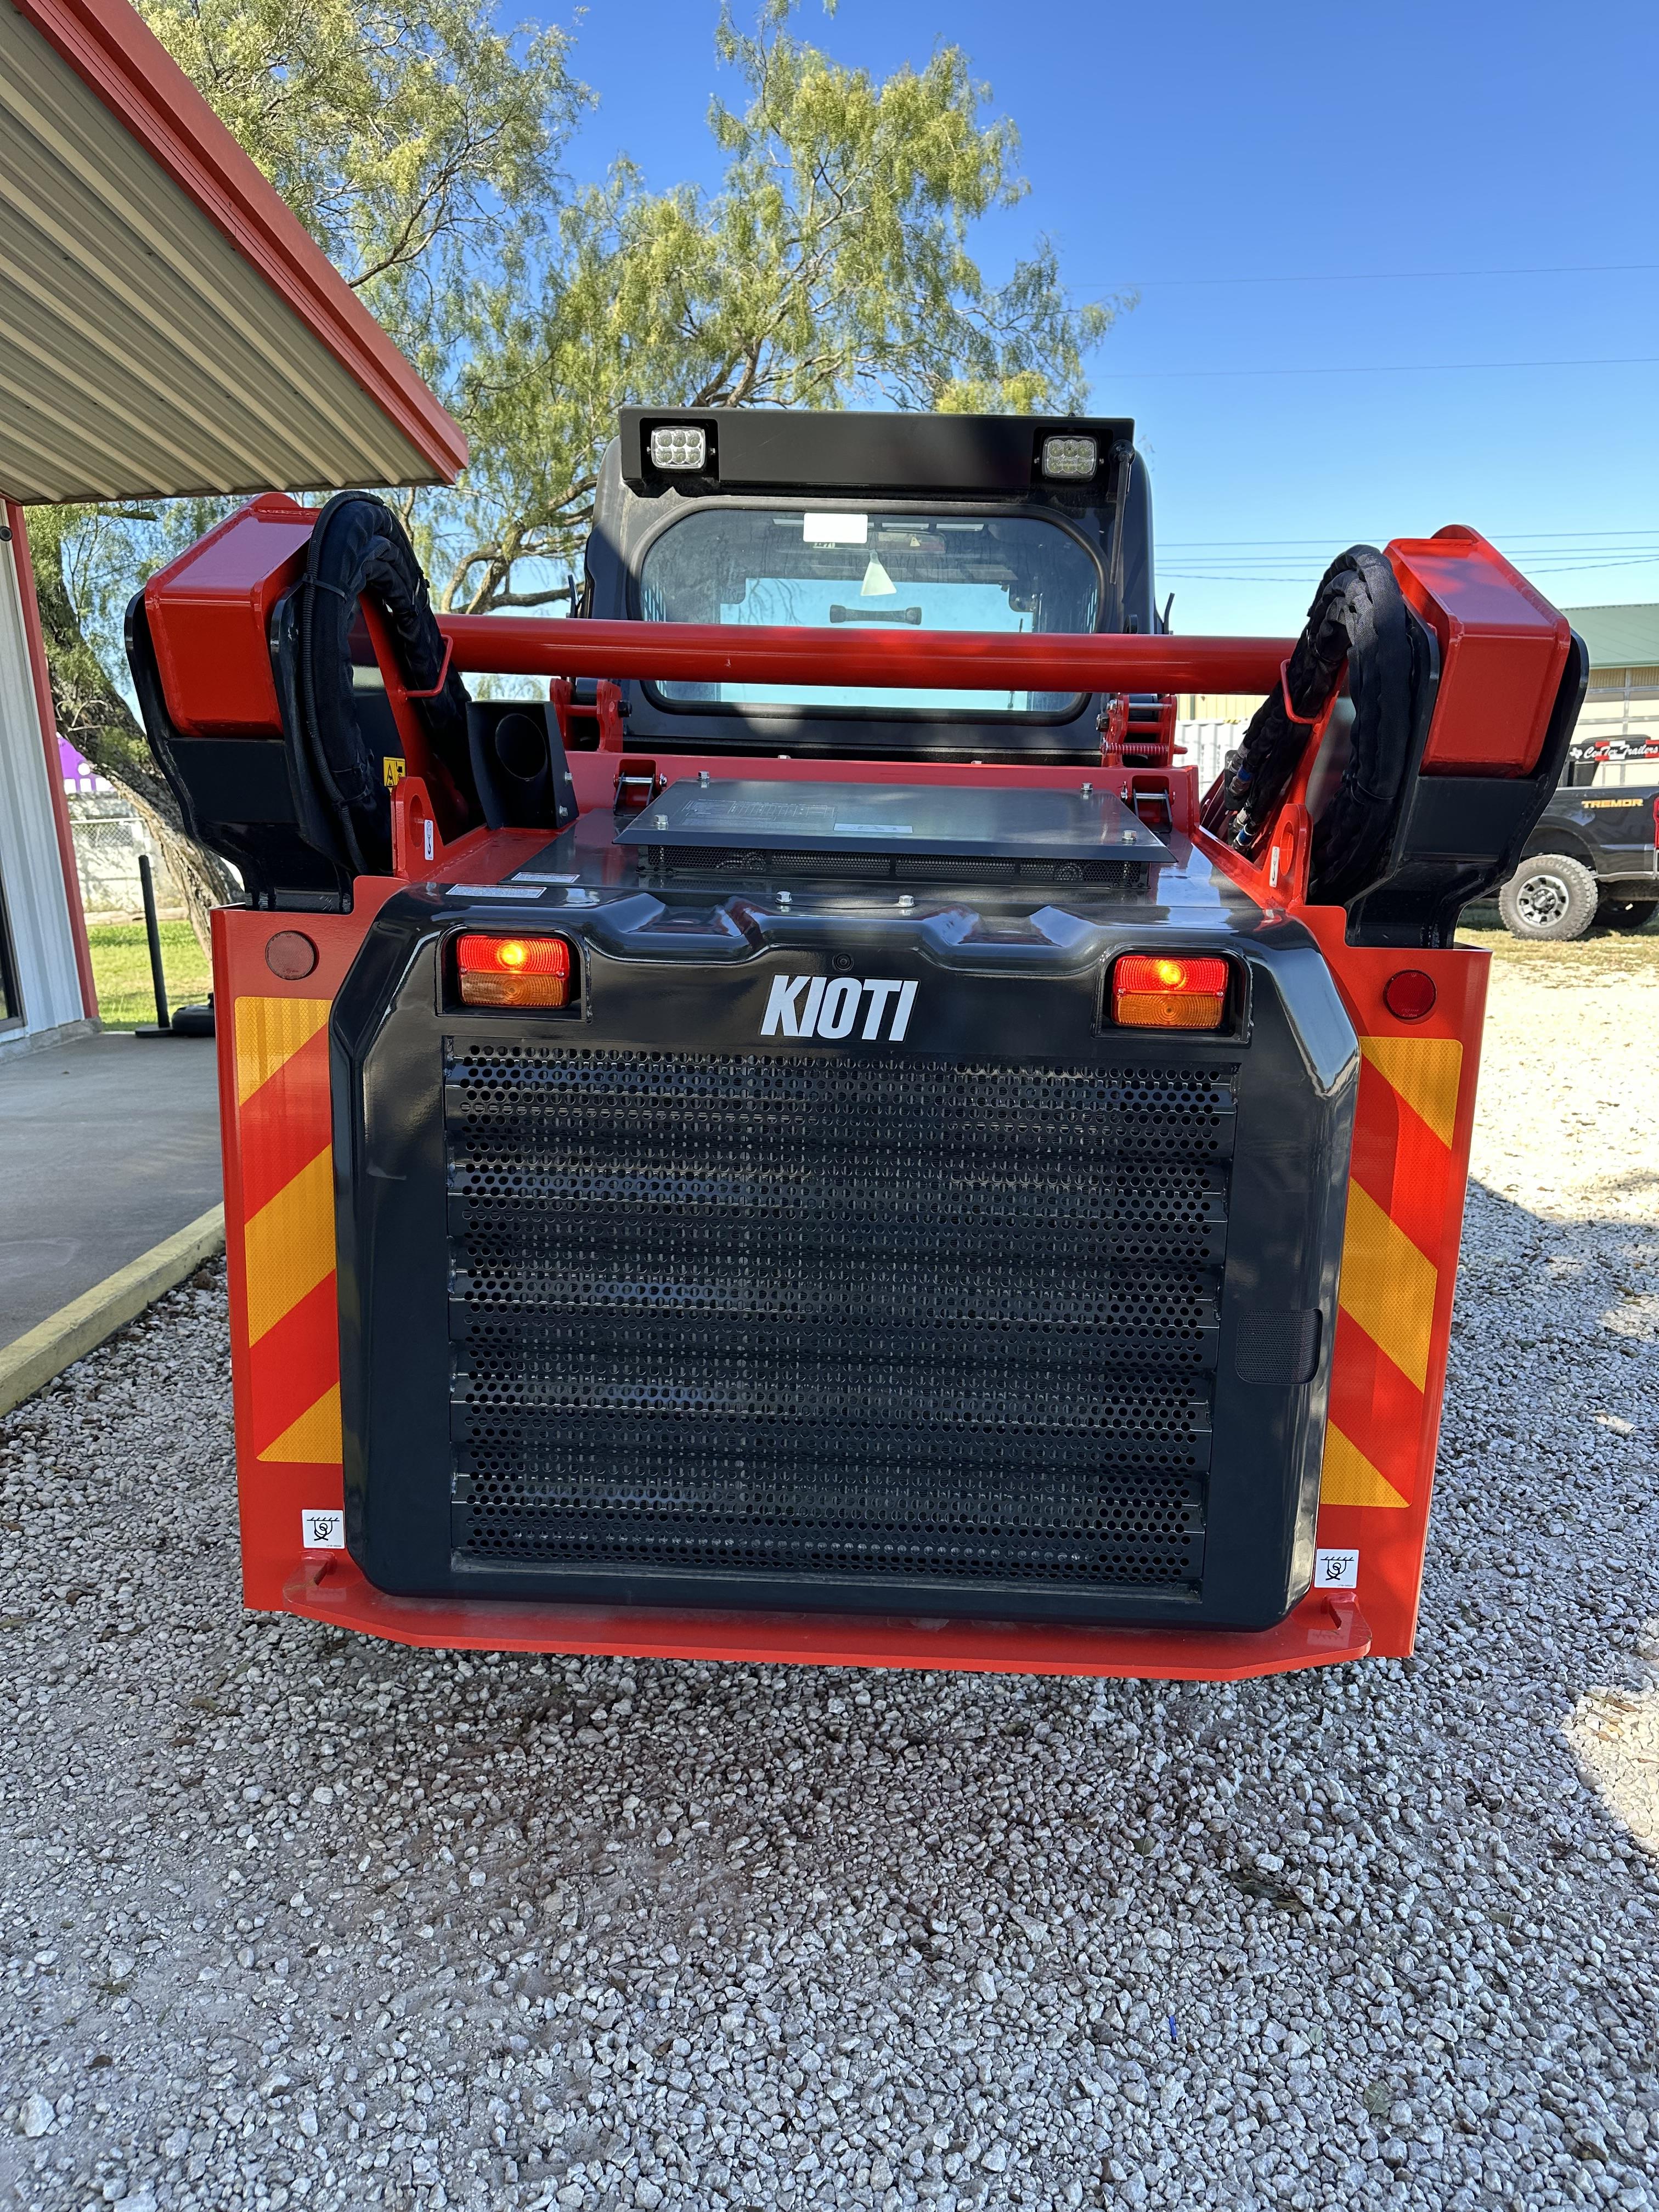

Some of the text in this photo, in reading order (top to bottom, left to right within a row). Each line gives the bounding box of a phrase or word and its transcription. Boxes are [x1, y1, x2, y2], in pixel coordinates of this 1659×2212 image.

[1619, 744, 1658, 755] Trailers
[1581, 798, 1644, 809] TREMOR
[760, 975, 918, 1041] KIOTI
